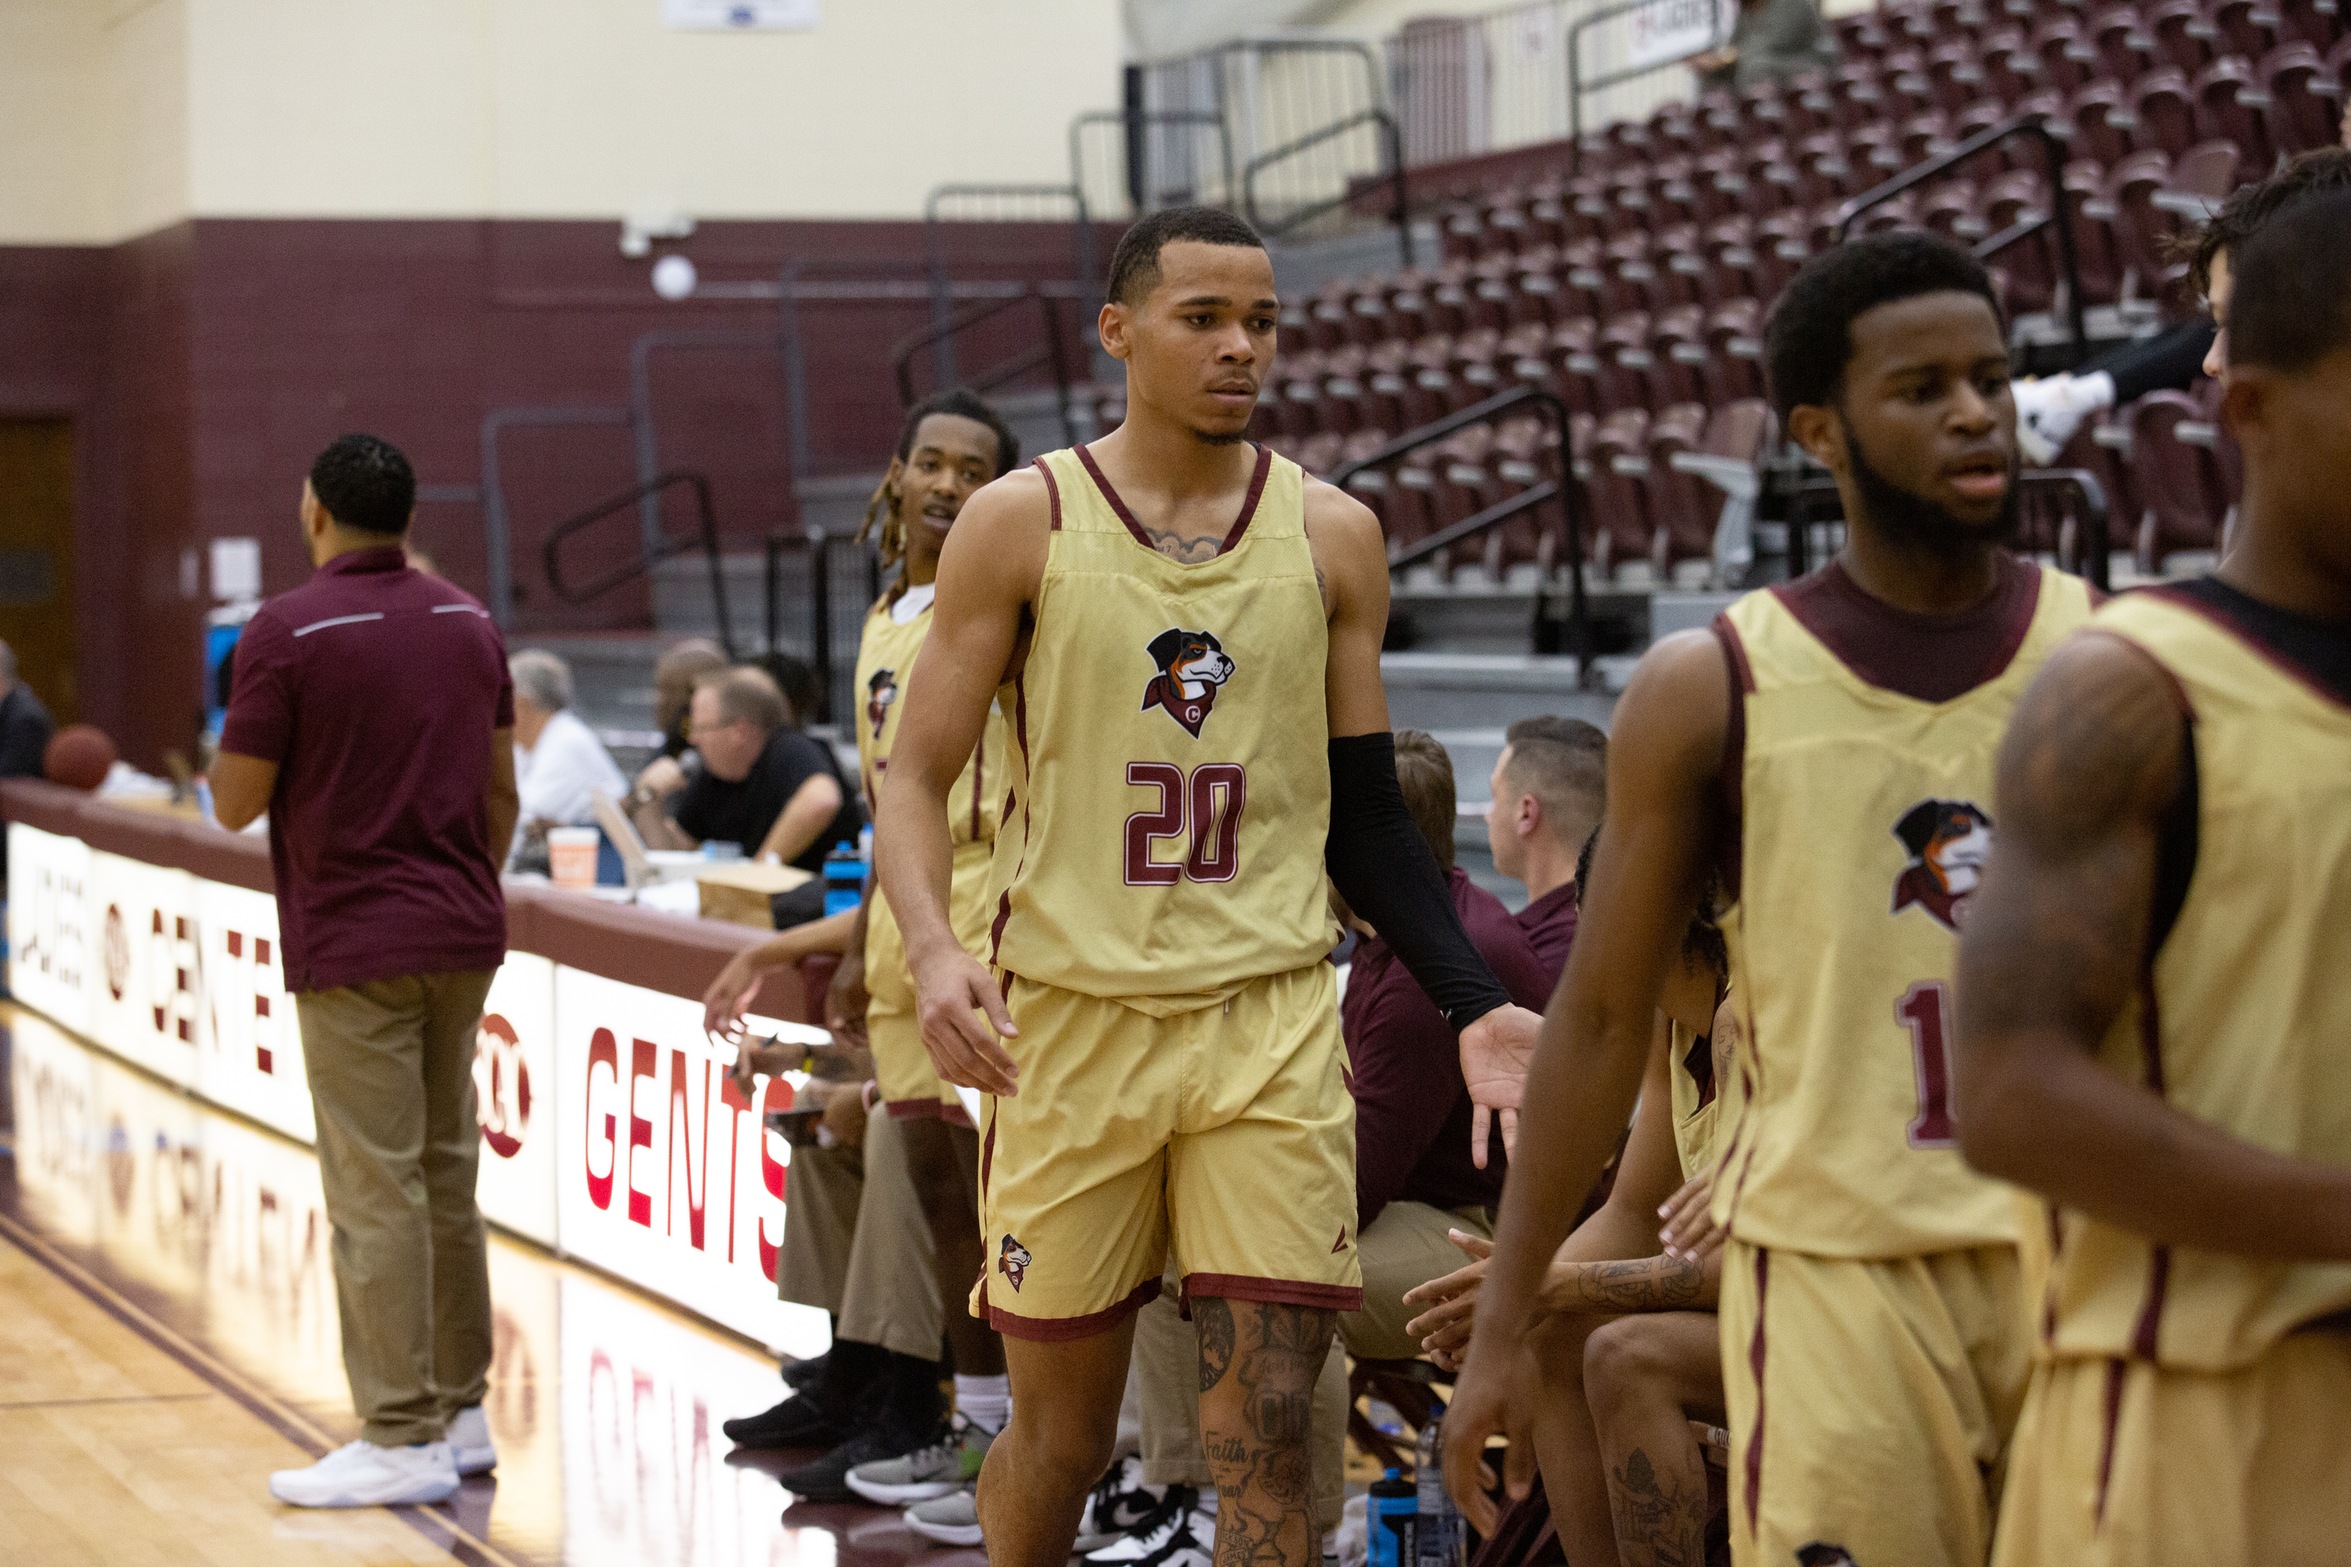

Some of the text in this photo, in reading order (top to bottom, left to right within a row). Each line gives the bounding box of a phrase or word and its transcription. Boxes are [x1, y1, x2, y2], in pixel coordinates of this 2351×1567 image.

[1124, 762, 1246, 886] 20
[585, 1026, 795, 1285] GENTS
[1206, 1431, 1250, 1463] Faith
